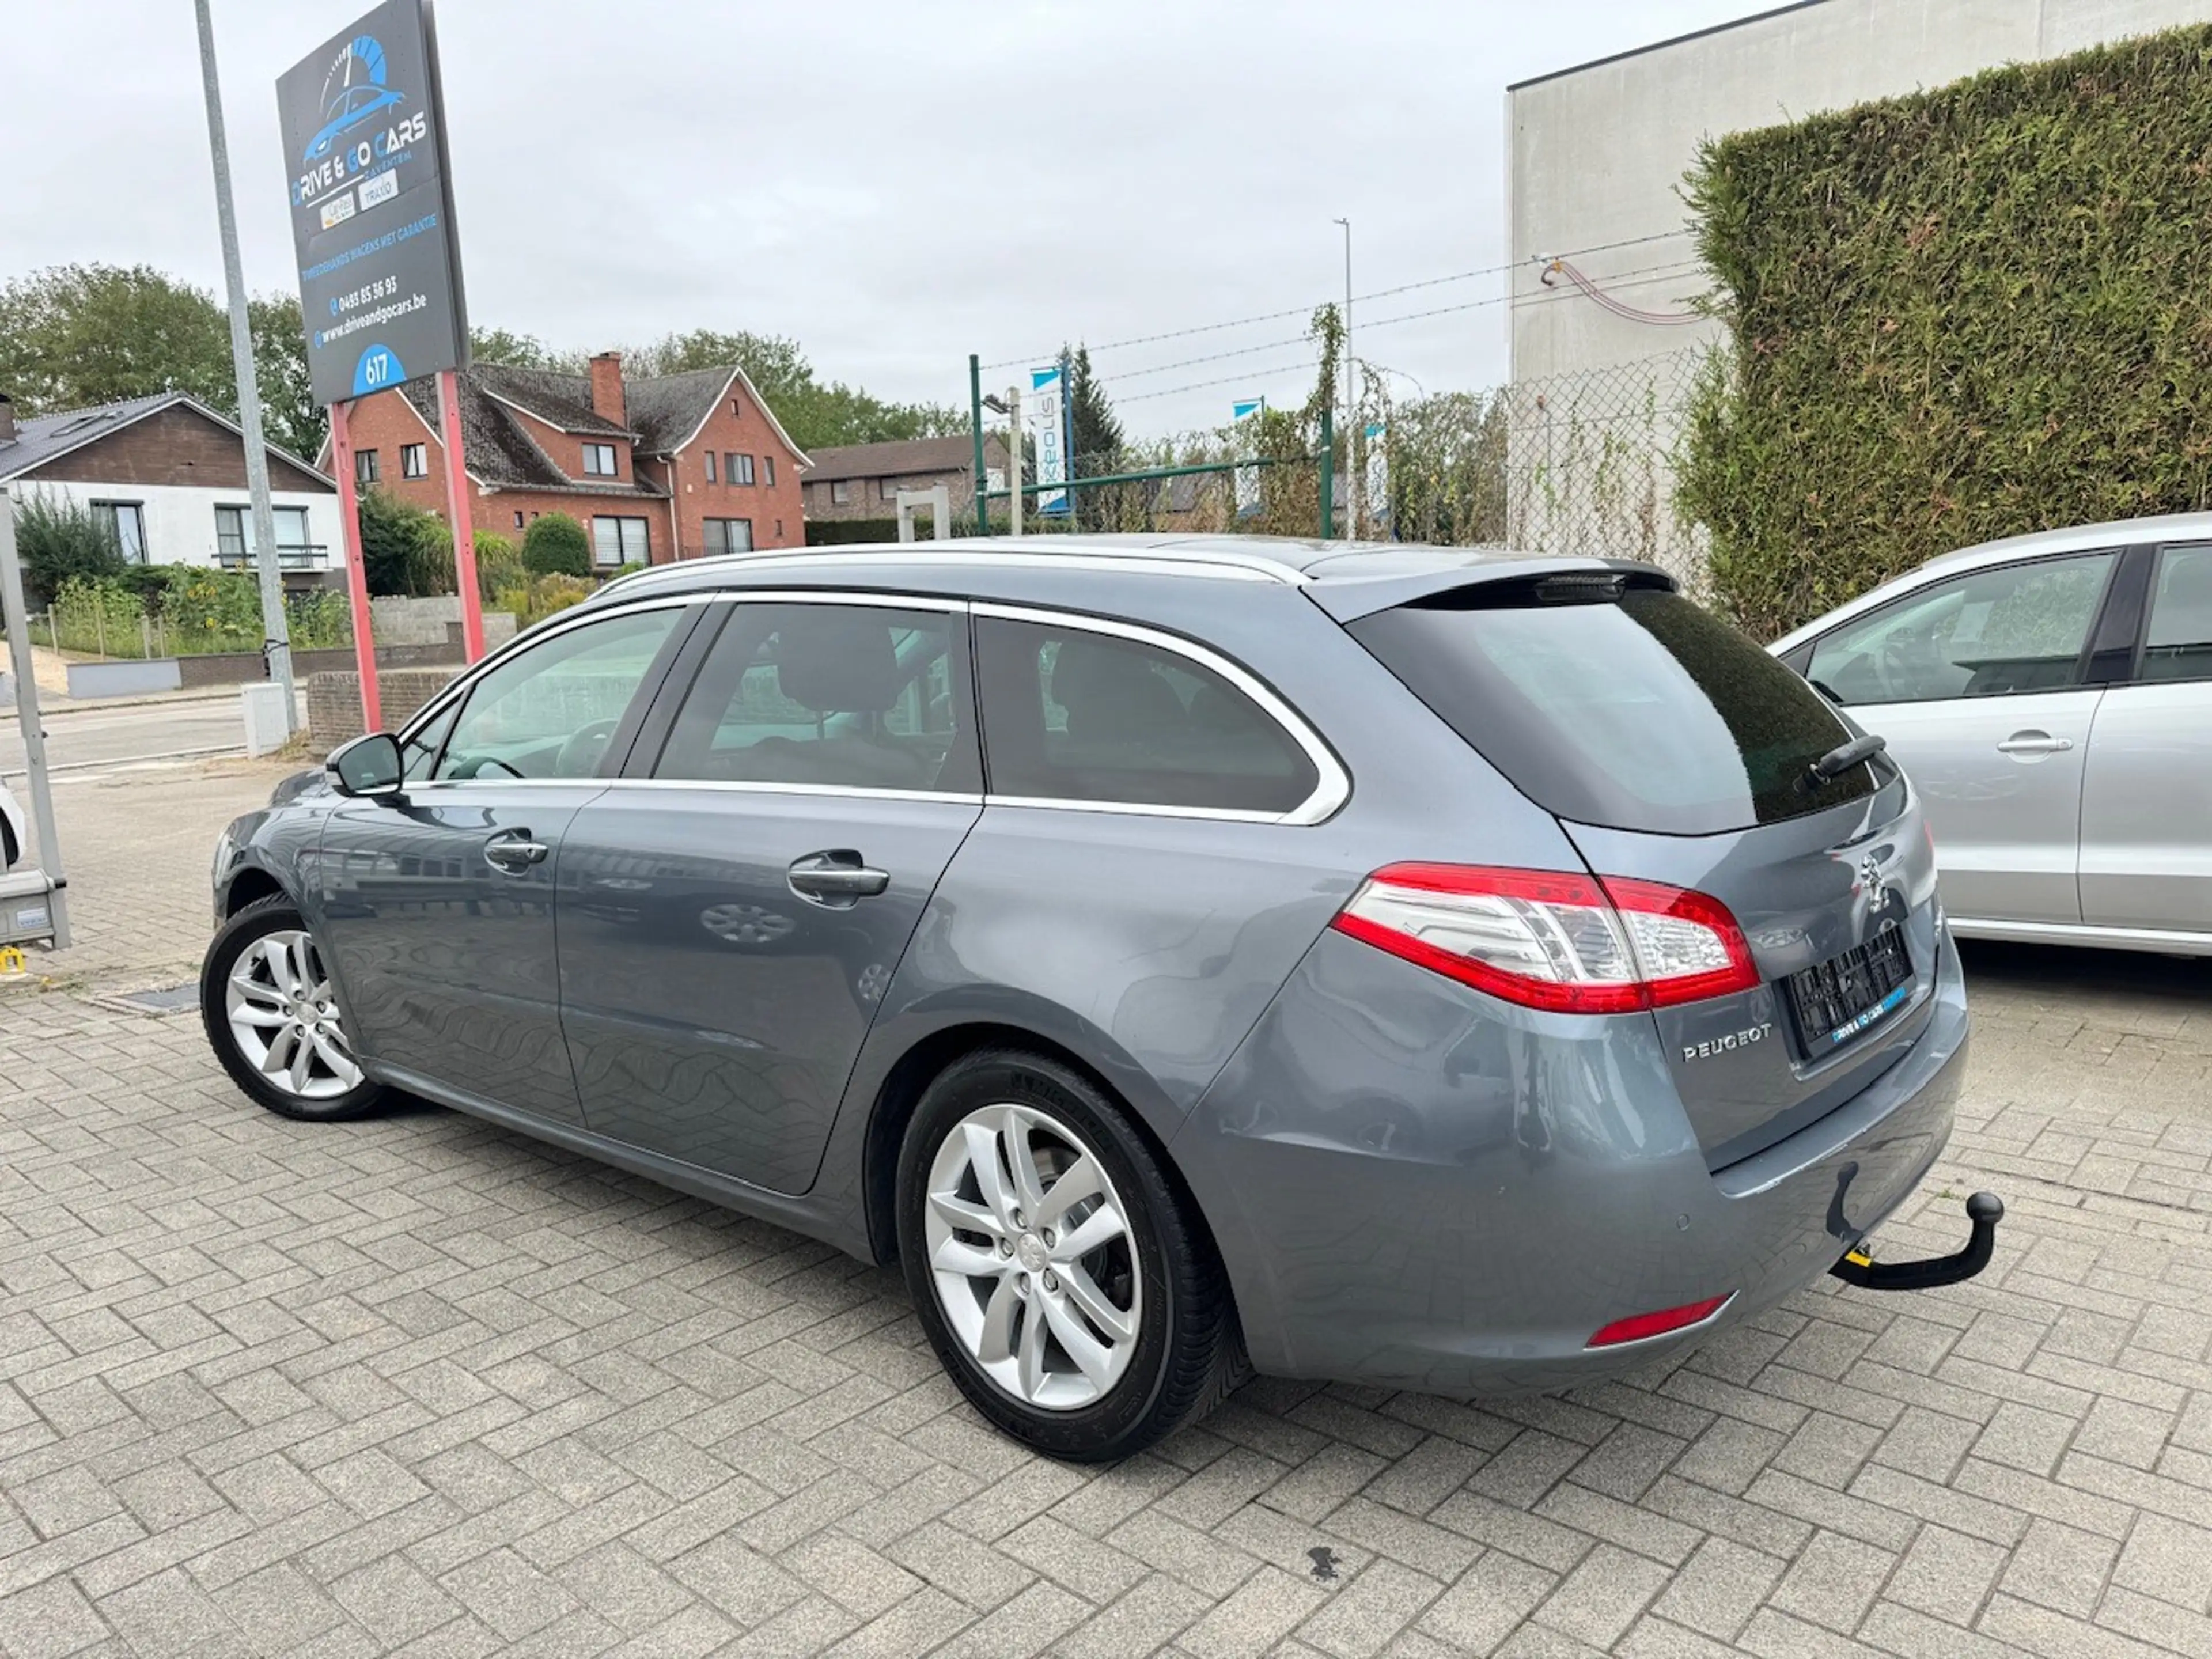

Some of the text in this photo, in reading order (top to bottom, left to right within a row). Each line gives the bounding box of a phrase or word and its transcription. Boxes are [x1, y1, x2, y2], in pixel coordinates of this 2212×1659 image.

[292, 111, 426, 206] DRIVE & GO CARS
[381, 232, 396, 249] MET
[397, 214, 437, 241] GARANTIE
[385, 276, 397, 295] 93
[322, 293, 427, 343] www.driveandgocars.be
[366, 353, 388, 385] 617
[1683, 1022, 1772, 1063] PEUGEOT
